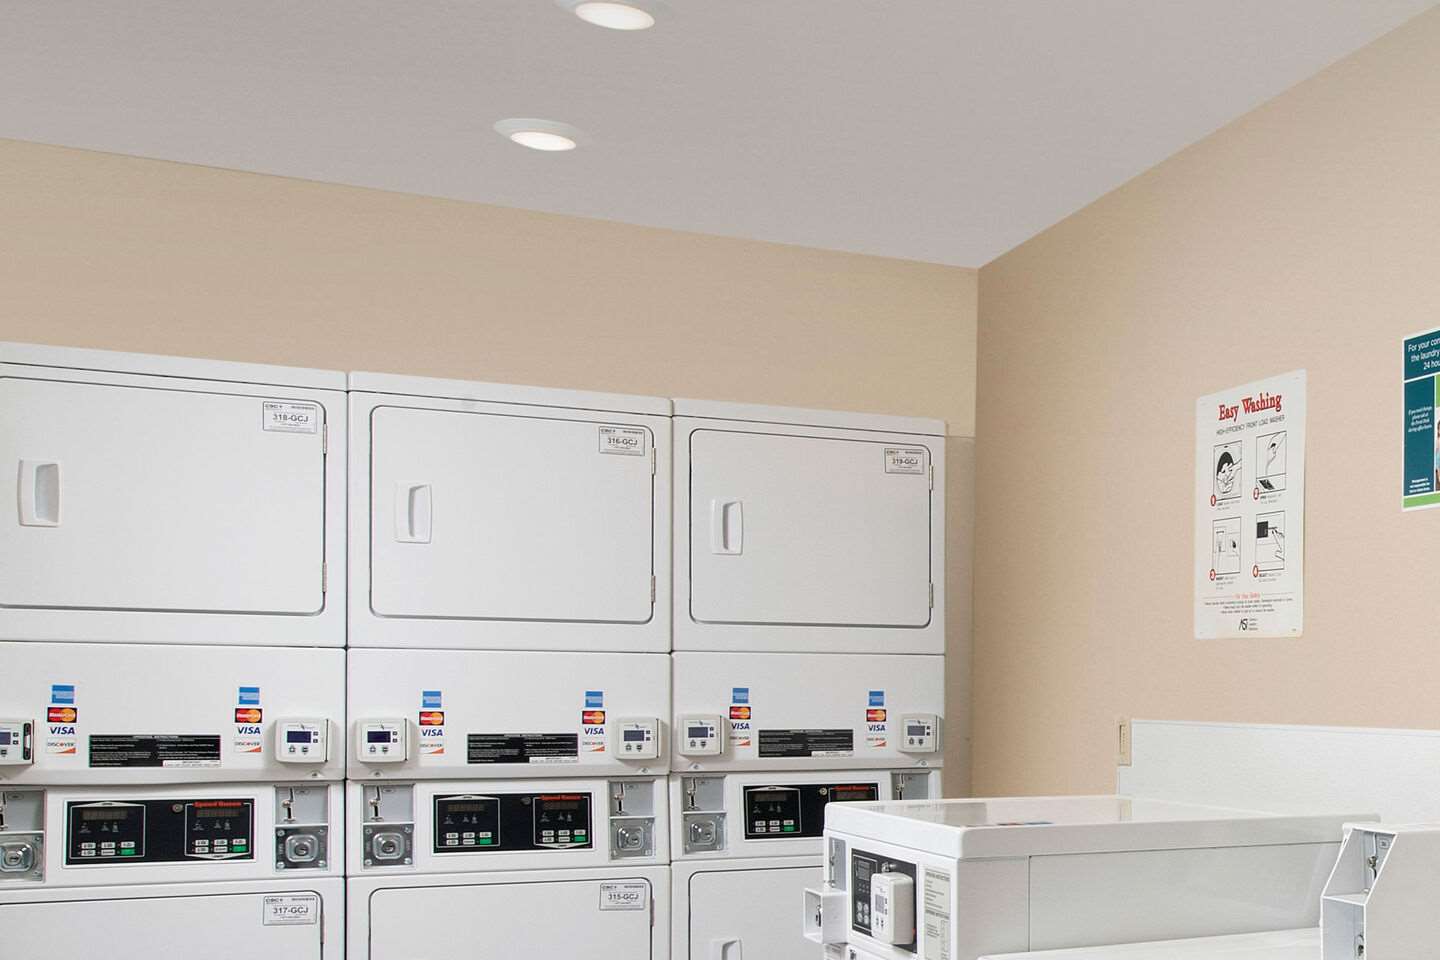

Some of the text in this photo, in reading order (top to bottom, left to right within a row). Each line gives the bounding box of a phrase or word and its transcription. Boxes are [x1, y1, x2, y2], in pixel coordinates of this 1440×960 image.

[1408, 344, 1417, 352] For
[1418, 341, 1430, 351] your
[1421, 349, 1440, 360] laundry
[1424, 362, 1430, 370] 24
[1218, 392, 1282, 422] Easy Washing
[50, 727, 75, 735] VISA
